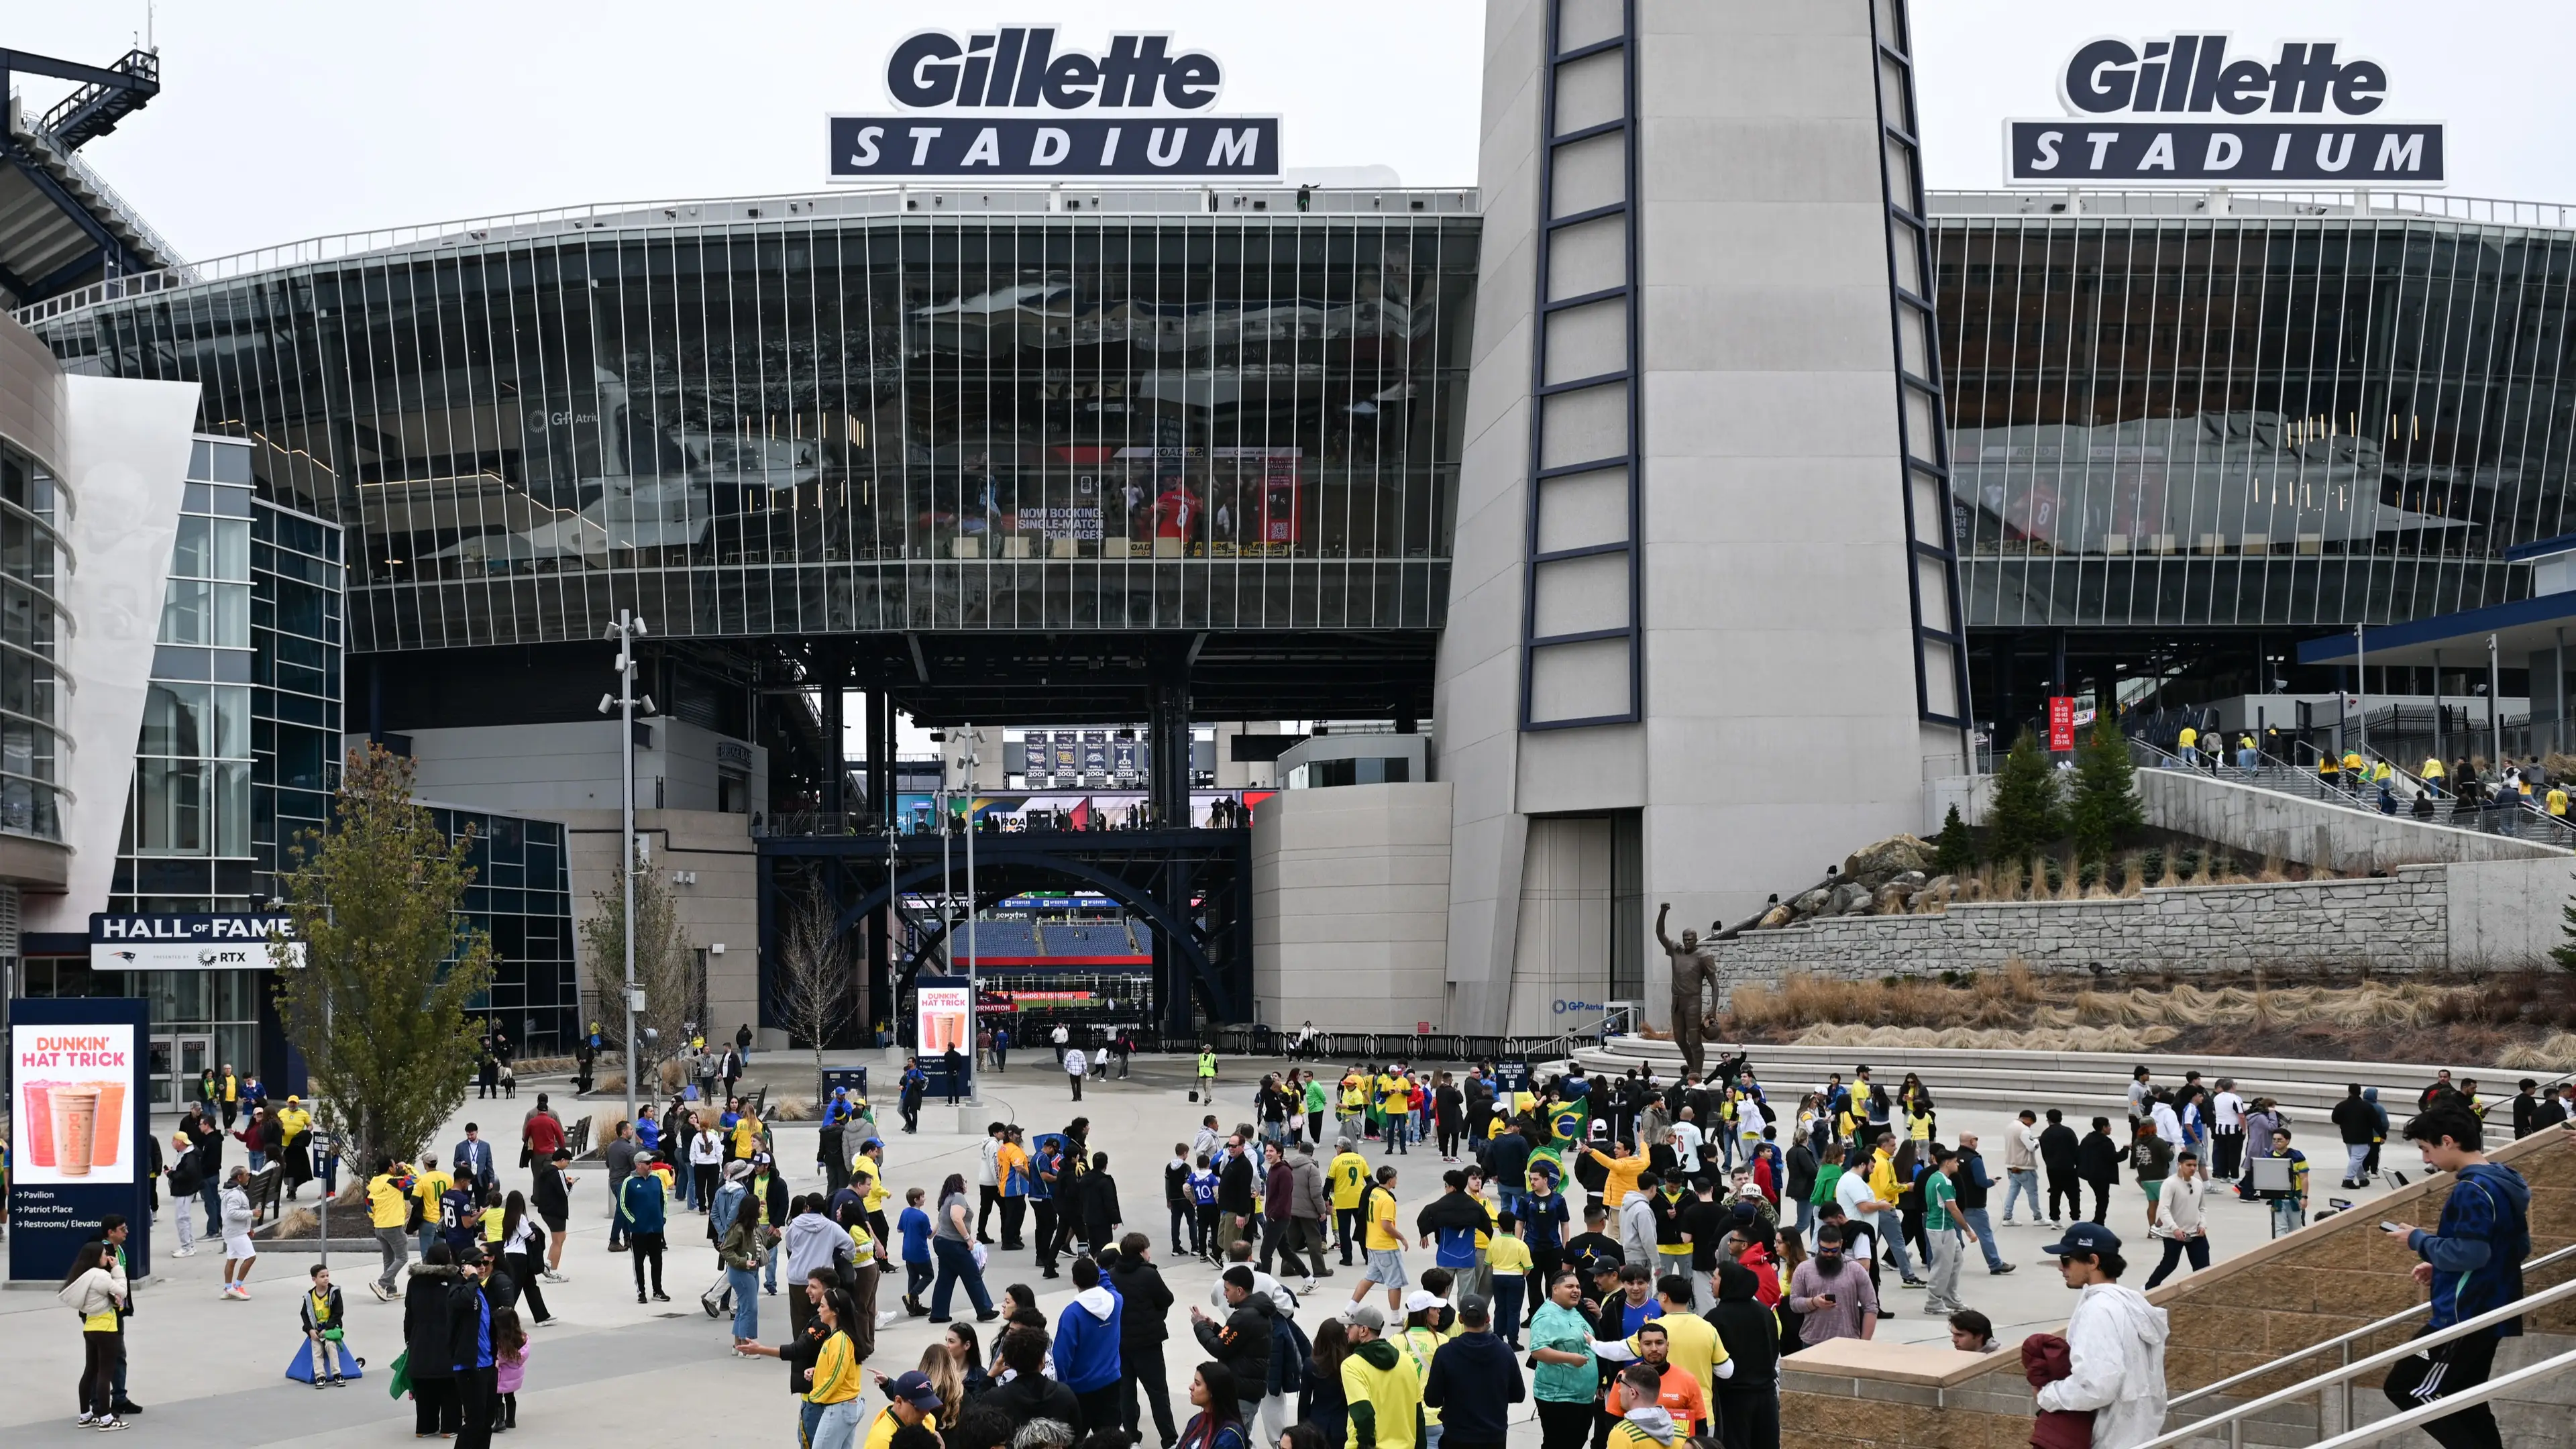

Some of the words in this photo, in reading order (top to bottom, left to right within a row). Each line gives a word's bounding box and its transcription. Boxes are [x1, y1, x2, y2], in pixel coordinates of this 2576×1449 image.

[888, 28, 1220, 109] Gillette
[2066, 36, 2387, 115] Gillette
[851, 127, 1259, 166] STADIUM
[2031, 132, 2424, 171] STADIUM
[576, 413, 599, 423] Atriu
[1020, 508, 1047, 518] NOW
[1050, 508, 1104, 518] BOOKING:
[1177, 504, 1189, 527] 8
[2038, 502, 2050, 525] 8
[1018, 519, 1104, 529] SINGLE-MATCH
[1044, 530, 1104, 539] PACKAGES
[103, 919, 191, 937] HALL
[193, 924, 209, 932] OF
[212, 918, 295, 937] FAME
[220, 953, 246, 962] RTX
[1568, 1002, 1585, 1010] GP
[37, 1037, 109, 1051] DUNKIN'
[22, 1053, 60, 1067] HAT
[66, 1052, 125, 1067] TRICK
[1678, 1135, 1684, 1152] 6
[1348, 1167, 1357, 1186] 9
[431, 1180, 446, 1201] 10
[1195, 1185, 1211, 1199] 10
[24, 1220, 68, 1228] Restrooms/
[443, 1205, 456, 1228] 19
[1224, 1332, 1238, 1345] vivo
